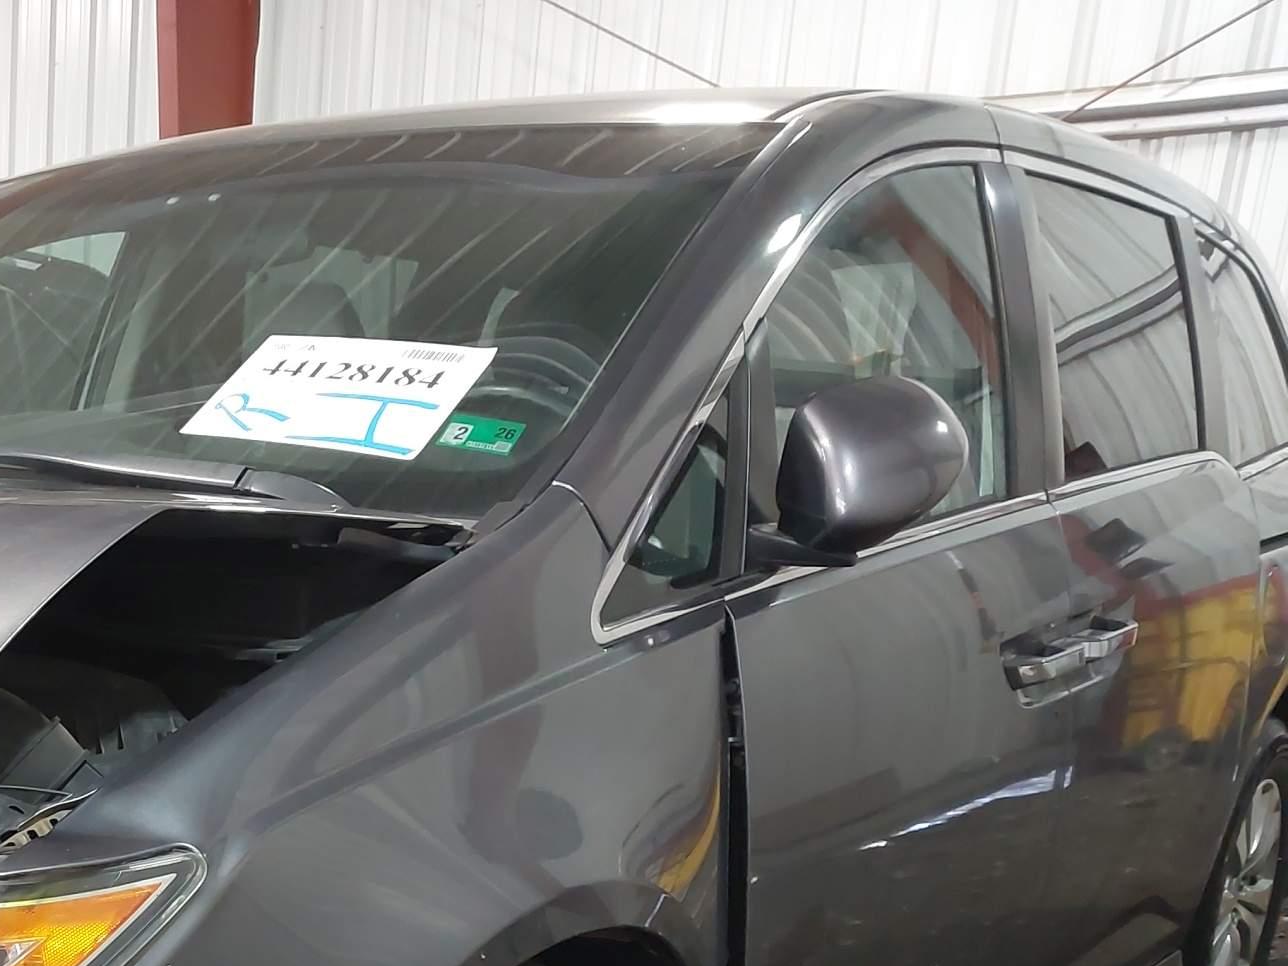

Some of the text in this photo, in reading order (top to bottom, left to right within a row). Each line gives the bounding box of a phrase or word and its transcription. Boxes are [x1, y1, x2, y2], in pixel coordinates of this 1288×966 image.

[262, 358, 446, 389] 44128184
[214, 393, 291, 432] R
[453, 426, 517, 441] 2 26
